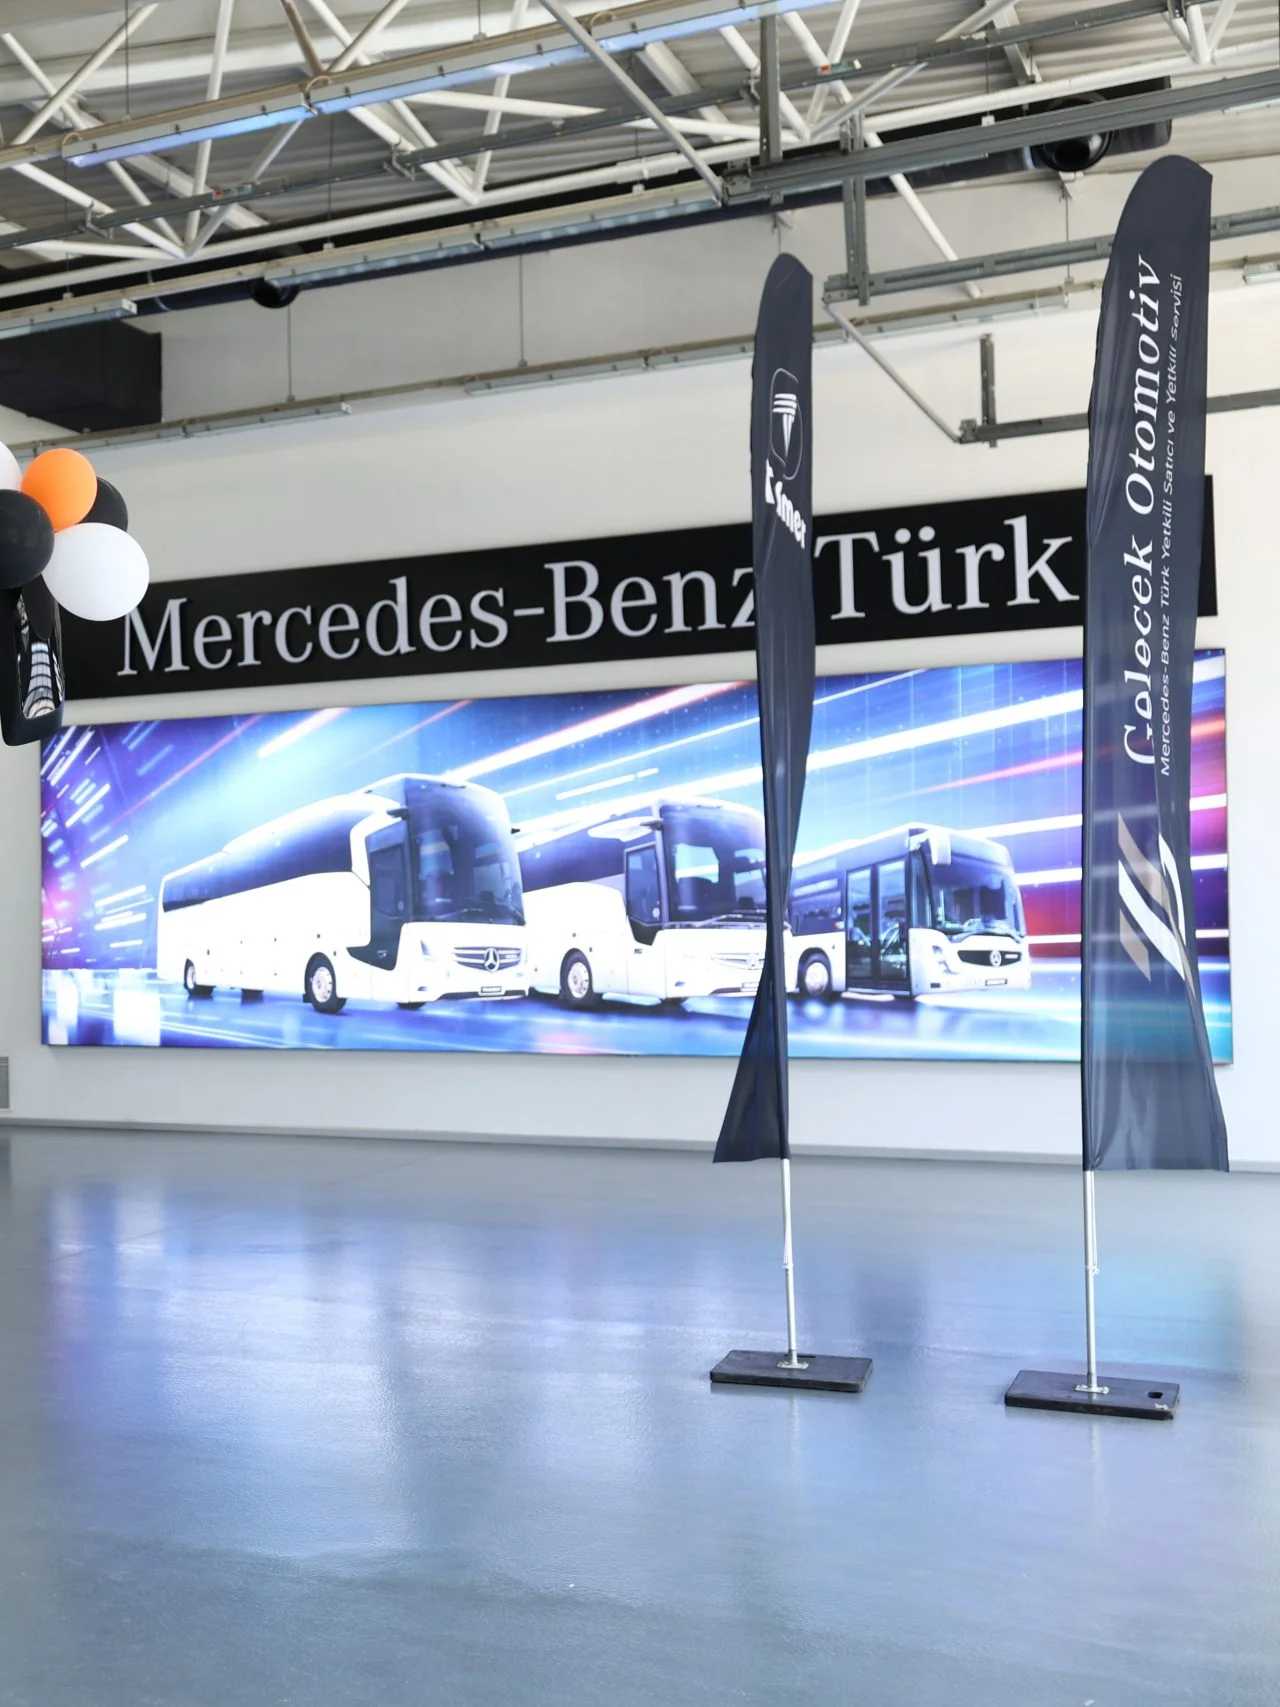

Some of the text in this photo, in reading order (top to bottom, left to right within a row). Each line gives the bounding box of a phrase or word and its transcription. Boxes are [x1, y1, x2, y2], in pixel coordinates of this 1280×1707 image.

[1170, 272, 1183, 341] Servisi
[1167, 410, 1176, 433] ve
[1163, 439, 1174, 496] Satıcı
[1124, 253, 1160, 764] Gelecek Otomotiv
[1161, 499, 1173, 559] Yetkili
[117, 515, 1080, 677] Mercedes-Benz Türk
[1161, 565, 1170, 607] Türk
[1161, 613, 1171, 776] Mercedes-Benz
